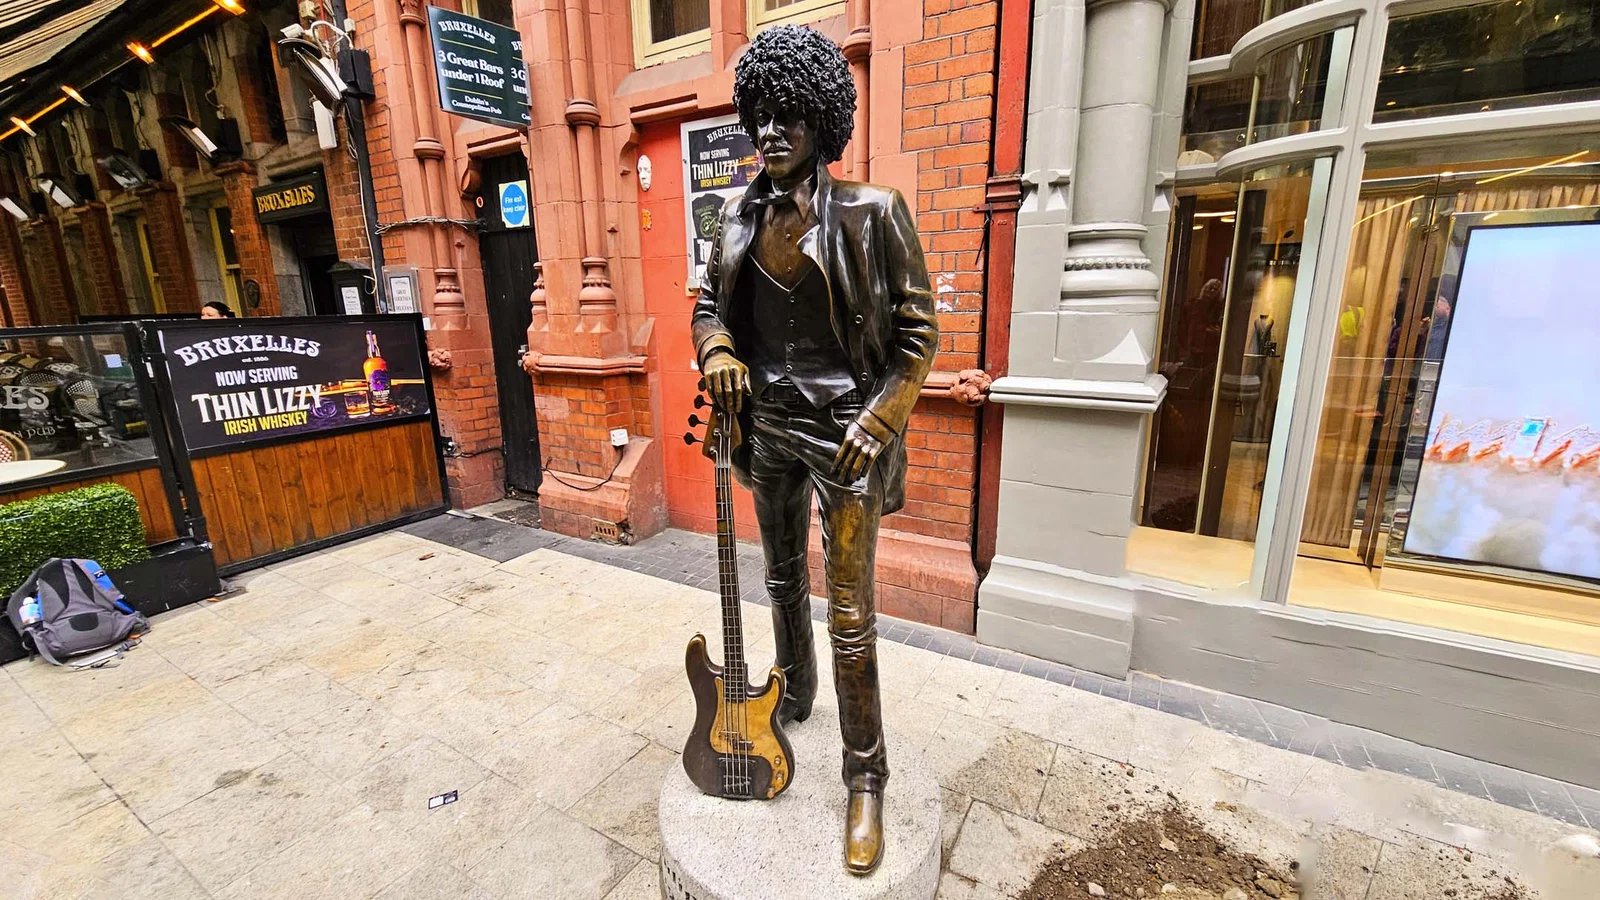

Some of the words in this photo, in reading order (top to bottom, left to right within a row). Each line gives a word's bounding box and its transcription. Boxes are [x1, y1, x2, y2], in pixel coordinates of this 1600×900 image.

[438, 21, 496, 44] BRUXELLES
[438, 50, 446, 62] 3
[447, 52, 479, 69] Great
[479, 59, 504, 75] Bars
[511, 67, 518, 79] 3
[441, 69, 474, 82] under
[475, 73, 480, 84] 1
[480, 74, 505, 88] Roof
[490, 107, 503, 115] Pub
[706, 125, 749, 143] BRUXELLE
[699, 151, 710, 160] NOW
[711, 148, 730, 159] SERVING
[692, 163, 714, 180] THIN
[714, 159, 739, 177] LIZZY
[256, 185, 316, 213] BRUXELLES
[174, 335, 321, 366] BRUXELLES
[215, 370, 246, 387] NOW
[249, 366, 298, 384] SERVING
[191, 391, 260, 423] THIN
[260, 384, 323, 415] LIZZY
[223, 418, 258, 436] IRISH
[258, 411, 308, 431] WHISKEY
